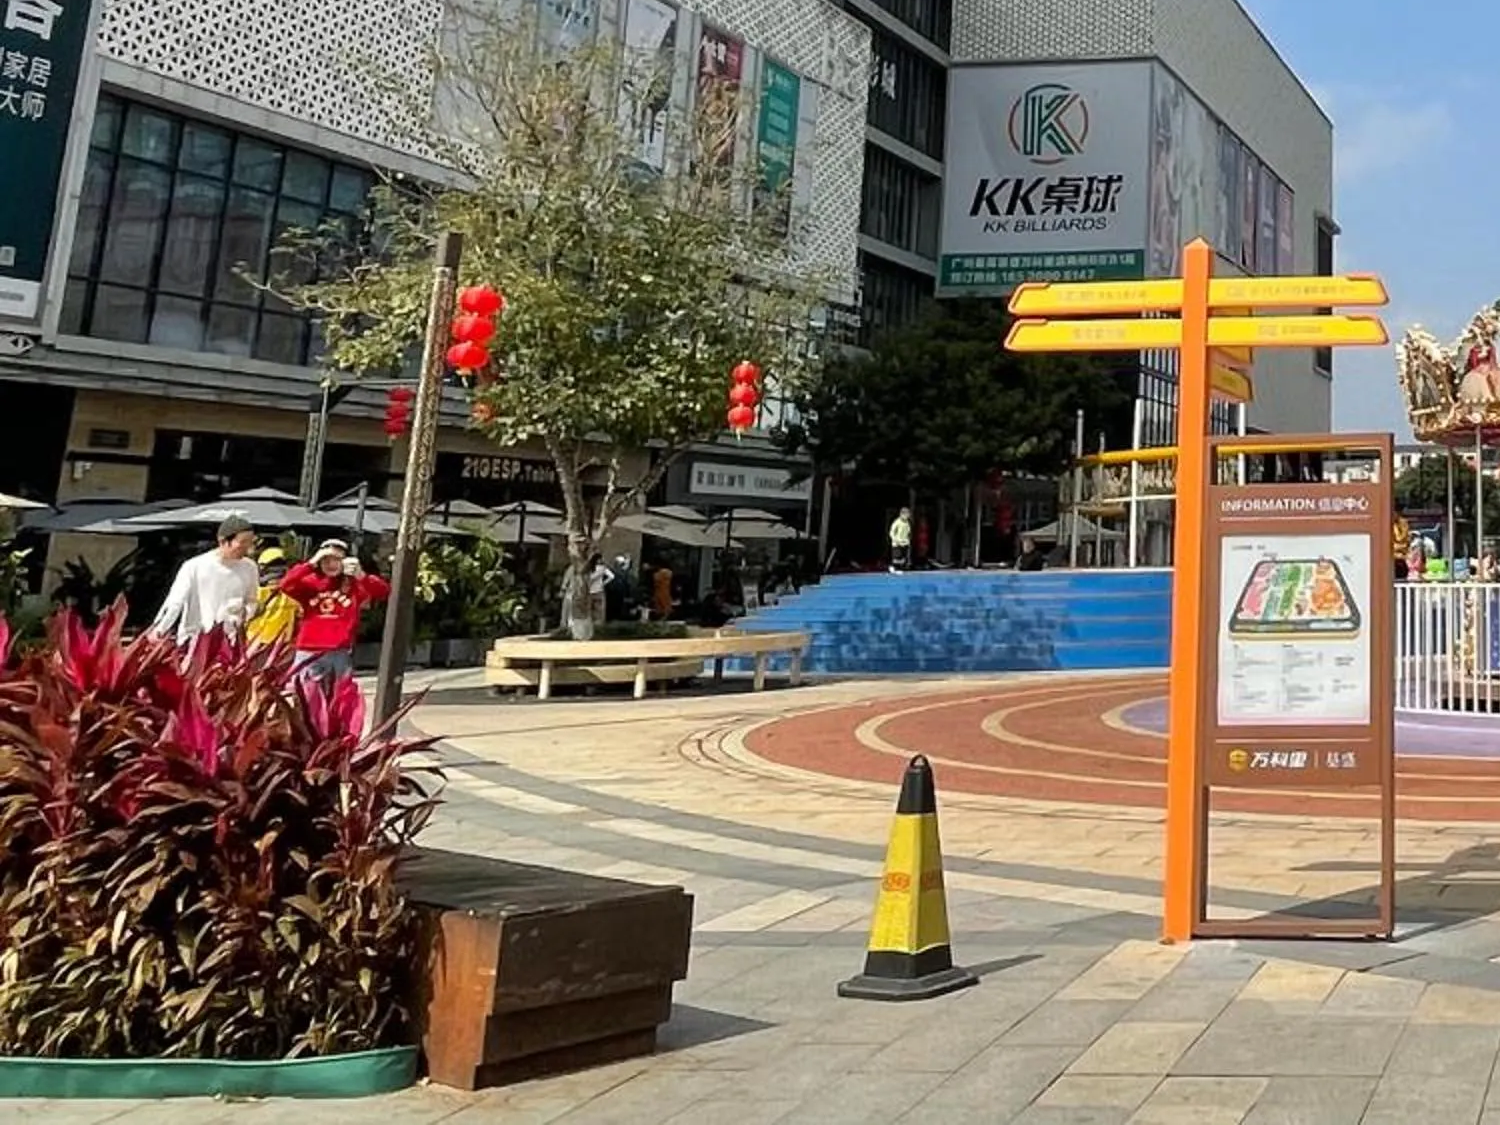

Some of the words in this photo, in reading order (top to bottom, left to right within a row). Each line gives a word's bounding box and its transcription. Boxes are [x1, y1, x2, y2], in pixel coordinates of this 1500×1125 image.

[0, 85, 47, 121] 大师
[969, 175, 1124, 217] KK桌球
[983, 220, 1009, 234] KK
[1013, 216, 1108, 233] BILLIARDS
[1221, 499, 1315, 512] INFORMATION
[1318, 497, 1369, 511] 信息中心
[1250, 751, 1308, 769] 万科里
